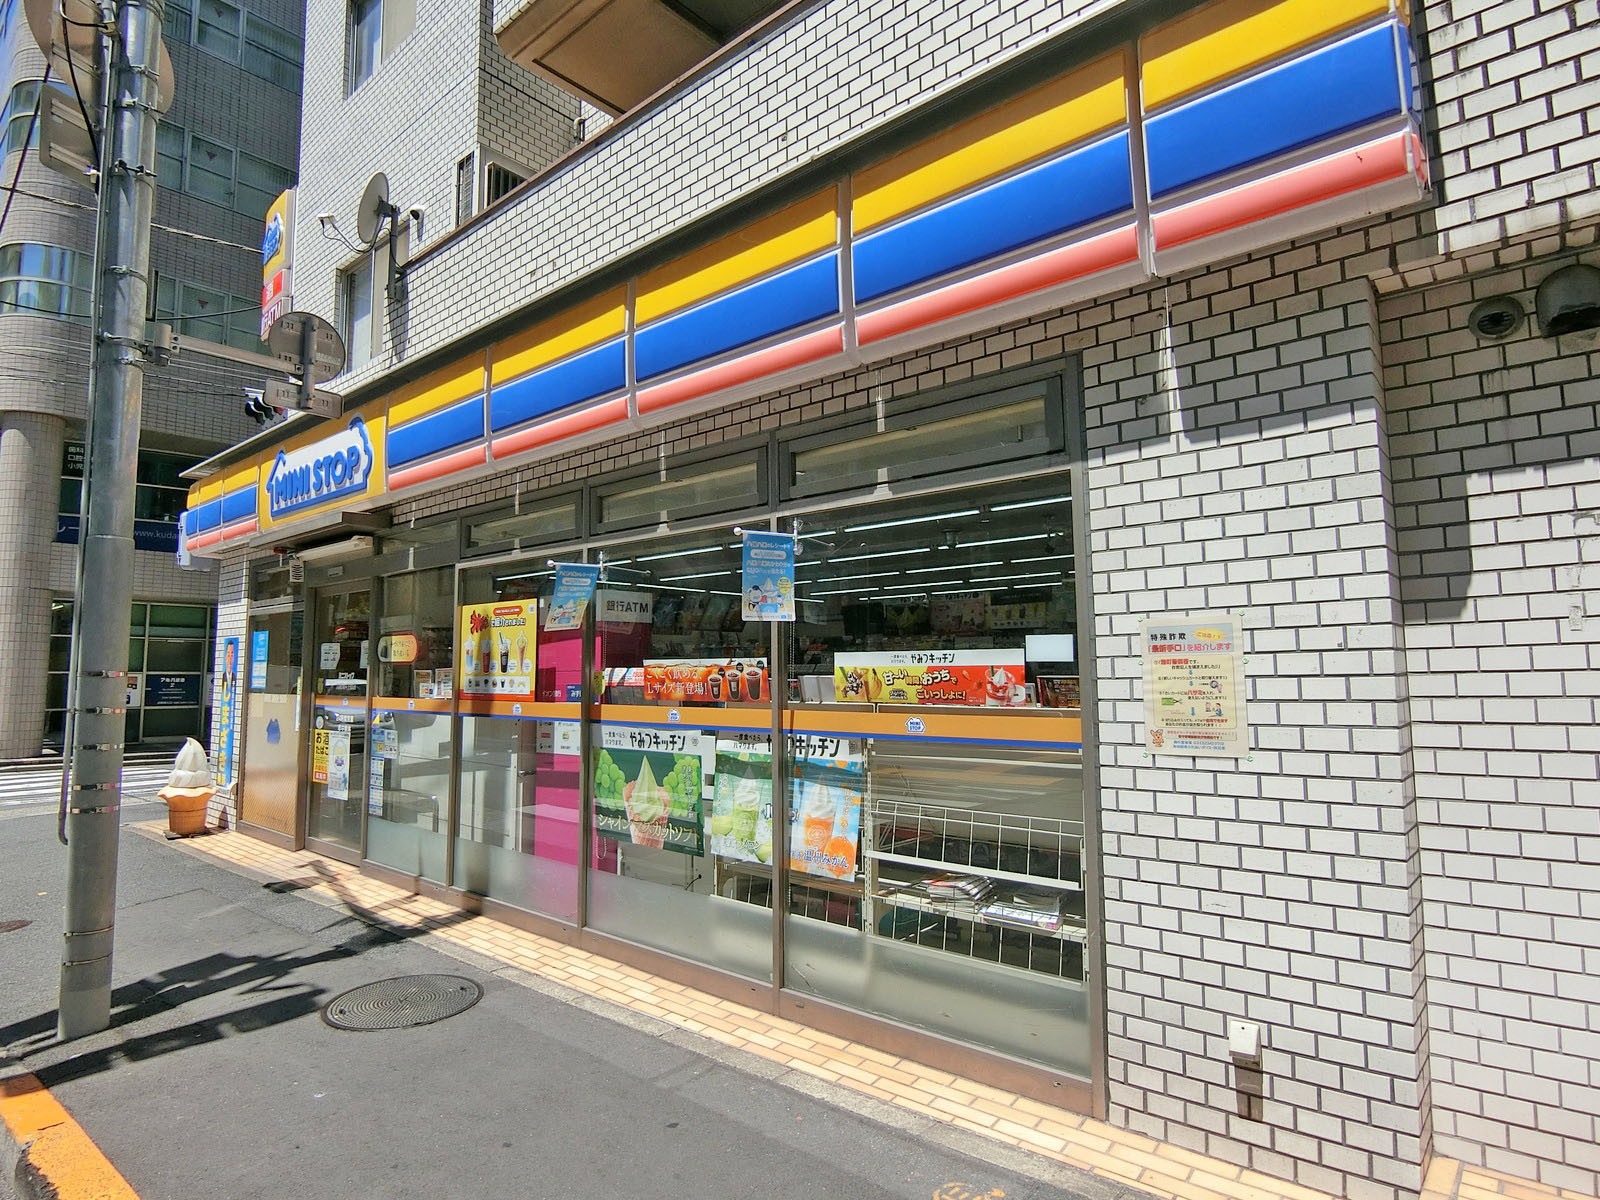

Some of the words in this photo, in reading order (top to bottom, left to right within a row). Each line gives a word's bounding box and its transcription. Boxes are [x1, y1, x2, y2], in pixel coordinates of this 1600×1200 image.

[275, 464, 311, 505] MINI
[312, 445, 361, 492] STOP
[606, 600, 649, 613] 銀行ATM
[1150, 632, 1187, 642] 特殊詐欺
[911, 653, 955, 664] やみつキッチン
[647, 681, 708, 696] Lサイズ新登場!
[629, 731, 686, 752] やみつキッチン
